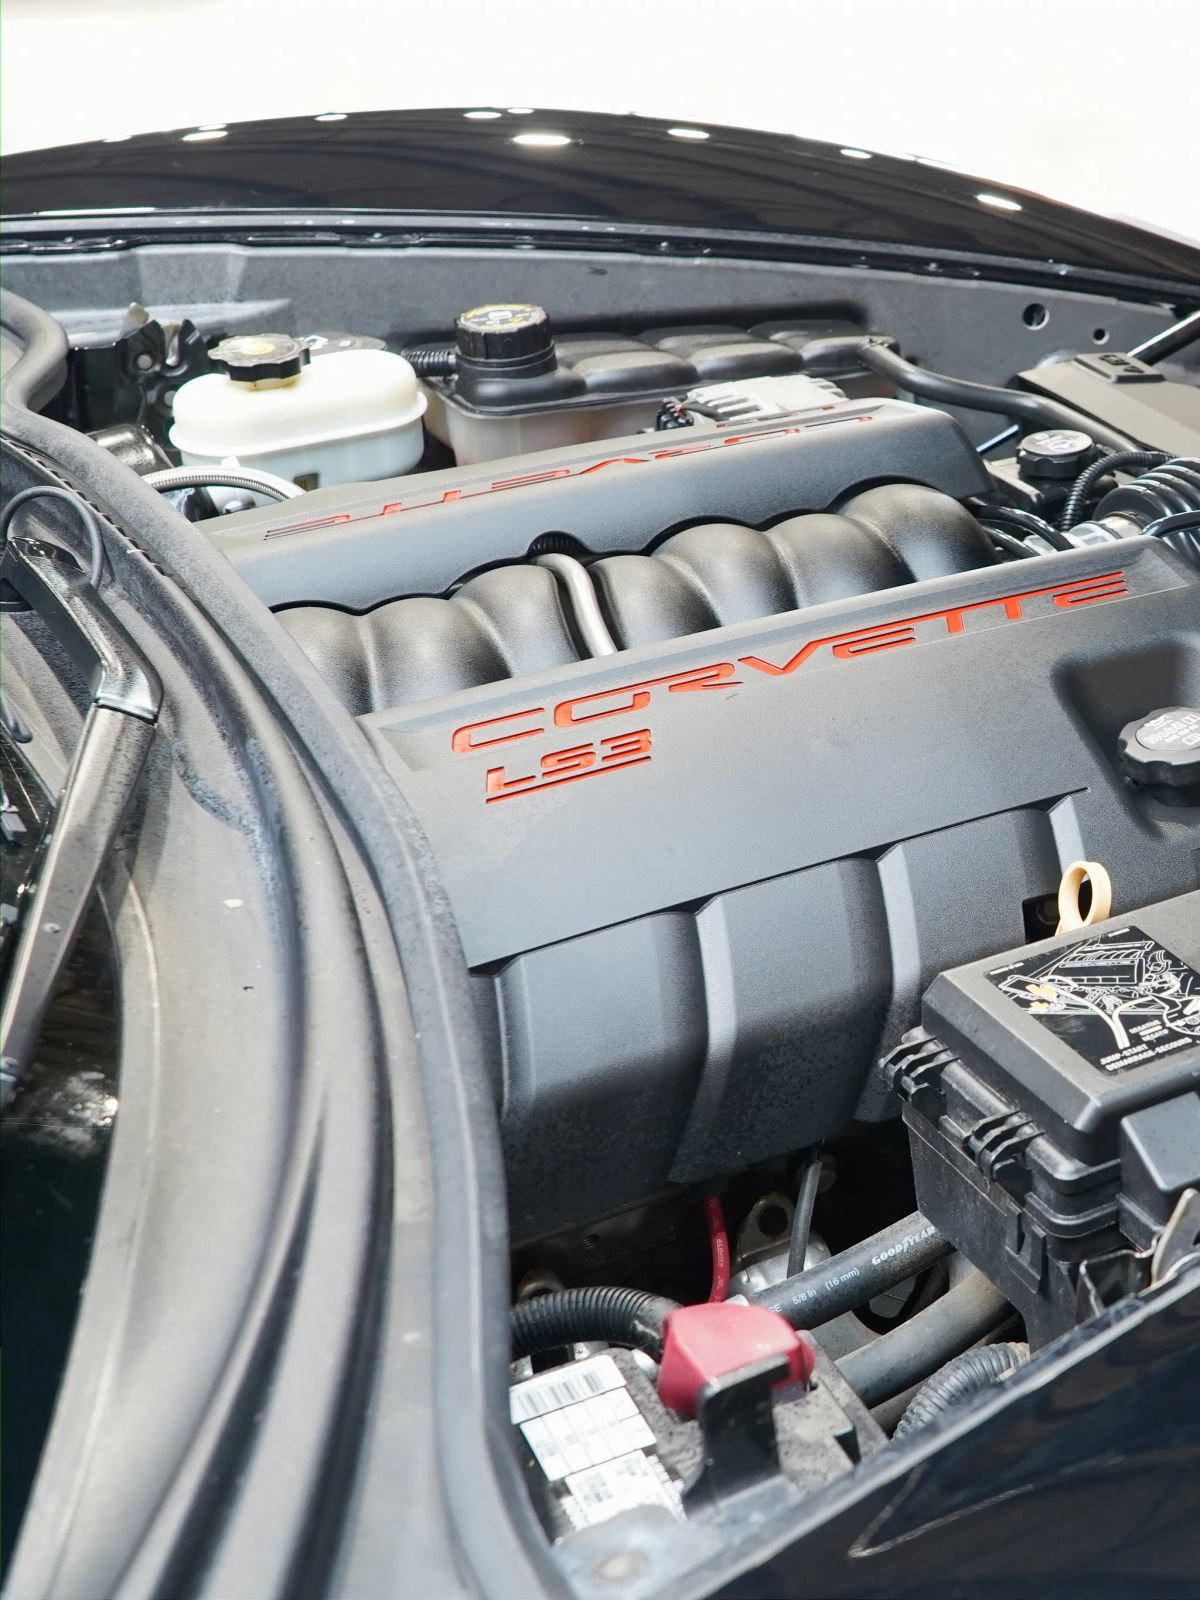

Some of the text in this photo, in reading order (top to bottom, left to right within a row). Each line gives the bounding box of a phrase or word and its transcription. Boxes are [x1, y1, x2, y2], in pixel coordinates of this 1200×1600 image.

[451, 570, 1128, 753] CORVETTE
[486, 728, 653, 795] LS3
[792, 1290, 808, 1306] 5/8
[824, 1277, 840, 1292] (16
[840, 1266, 860, 1284] mm)
[871, 1225, 937, 1266] GOODYEAR
